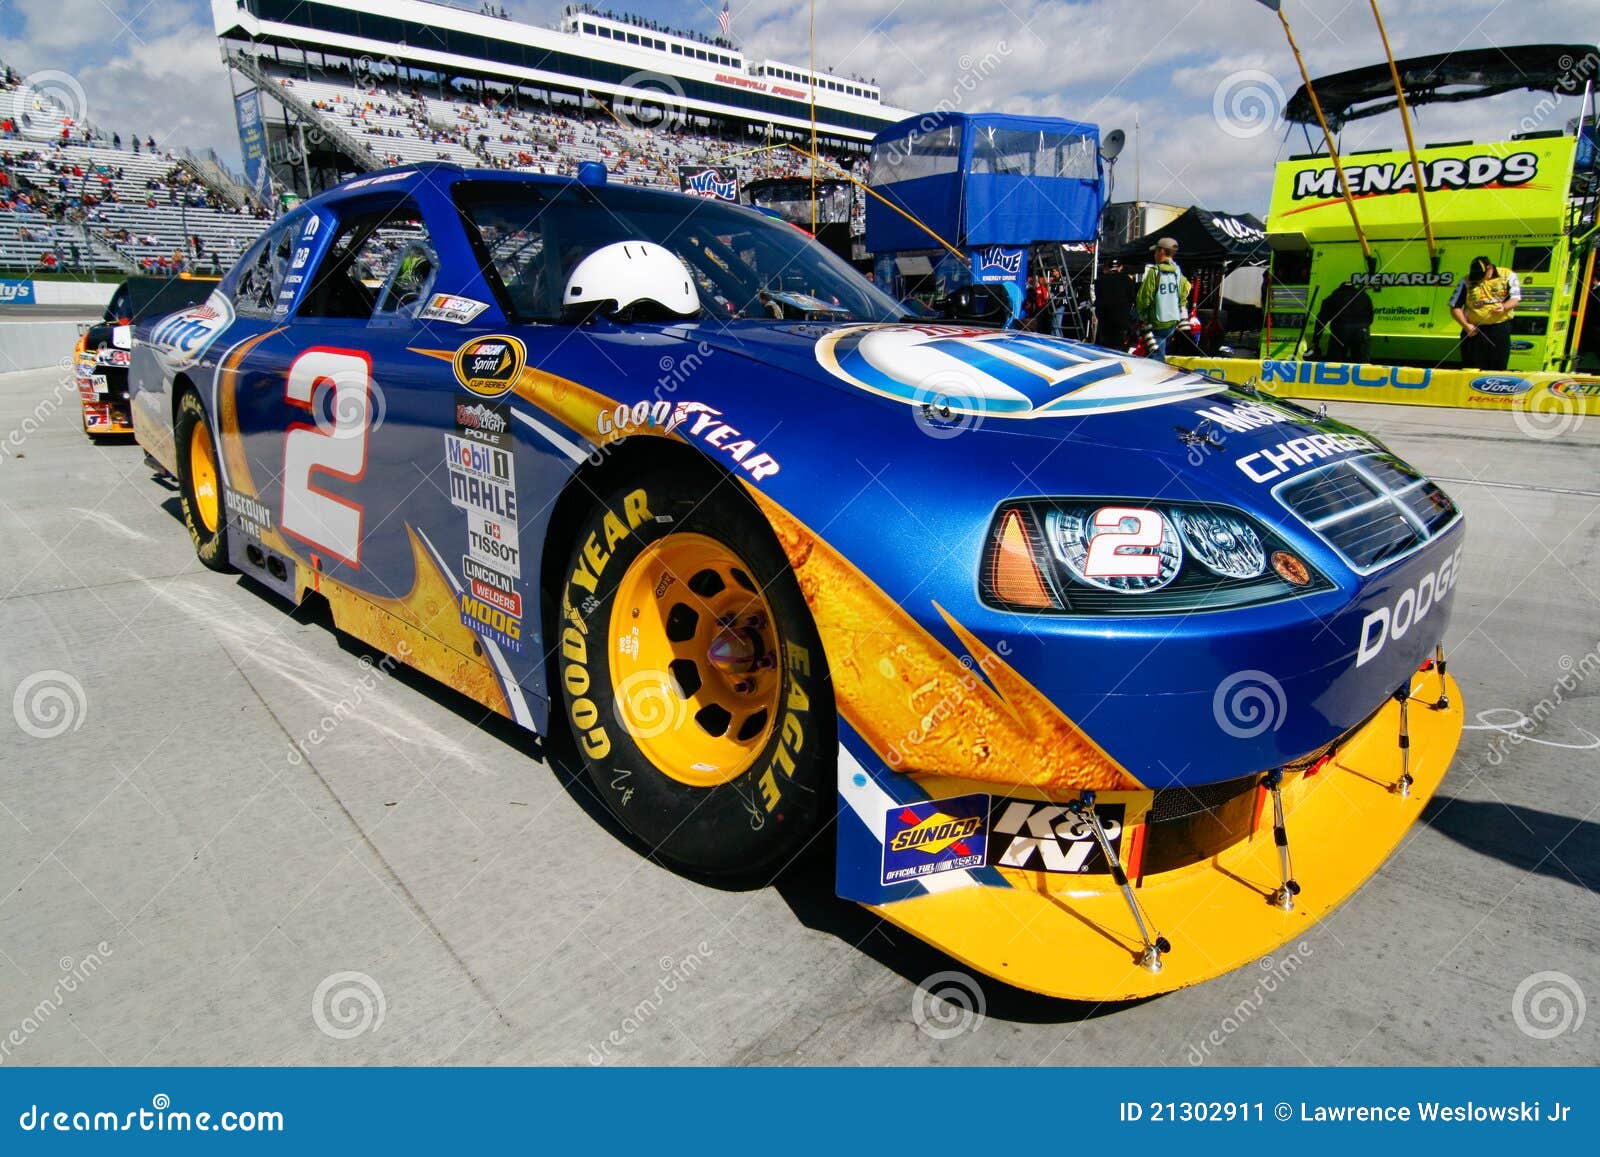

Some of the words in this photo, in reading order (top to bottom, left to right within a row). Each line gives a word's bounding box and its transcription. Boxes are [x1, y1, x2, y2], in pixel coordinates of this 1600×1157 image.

[688, 169, 737, 200] WAVE
[1292, 151, 1538, 200] MENARDS
[979, 246, 1022, 274] WAVE
[1351, 272, 1454, 286] MENARDS
[445, 310, 467, 321] CAR
[472, 357, 499, 374] Sprint
[1481, 378, 1521, 393] Ford
[464, 428, 501, 444] POLE
[480, 416, 507, 434] LIGHT
[279, 346, 374, 570] 2
[447, 437, 491, 475] Mobil
[226, 489, 272, 530] DISCOUNT
[451, 471, 517, 521] MAHLE
[239, 516, 261, 539] TIRE
[1083, 505, 1163, 577] 2
[470, 530, 518, 565] TISSOT
[465, 560, 510, 593] LINCOLN
[476, 583, 517, 611] WELDERS
[1356, 543, 1463, 668] DODGE
[461, 593, 521, 640] MOOG
[562, 487, 655, 760] GOODYEAR
[758, 640, 811, 813] EAGLE
[894, 817, 978, 848] SUNOCO
[886, 865, 917, 880] OFFICIAL
[918, 862, 936, 875] FUEL
